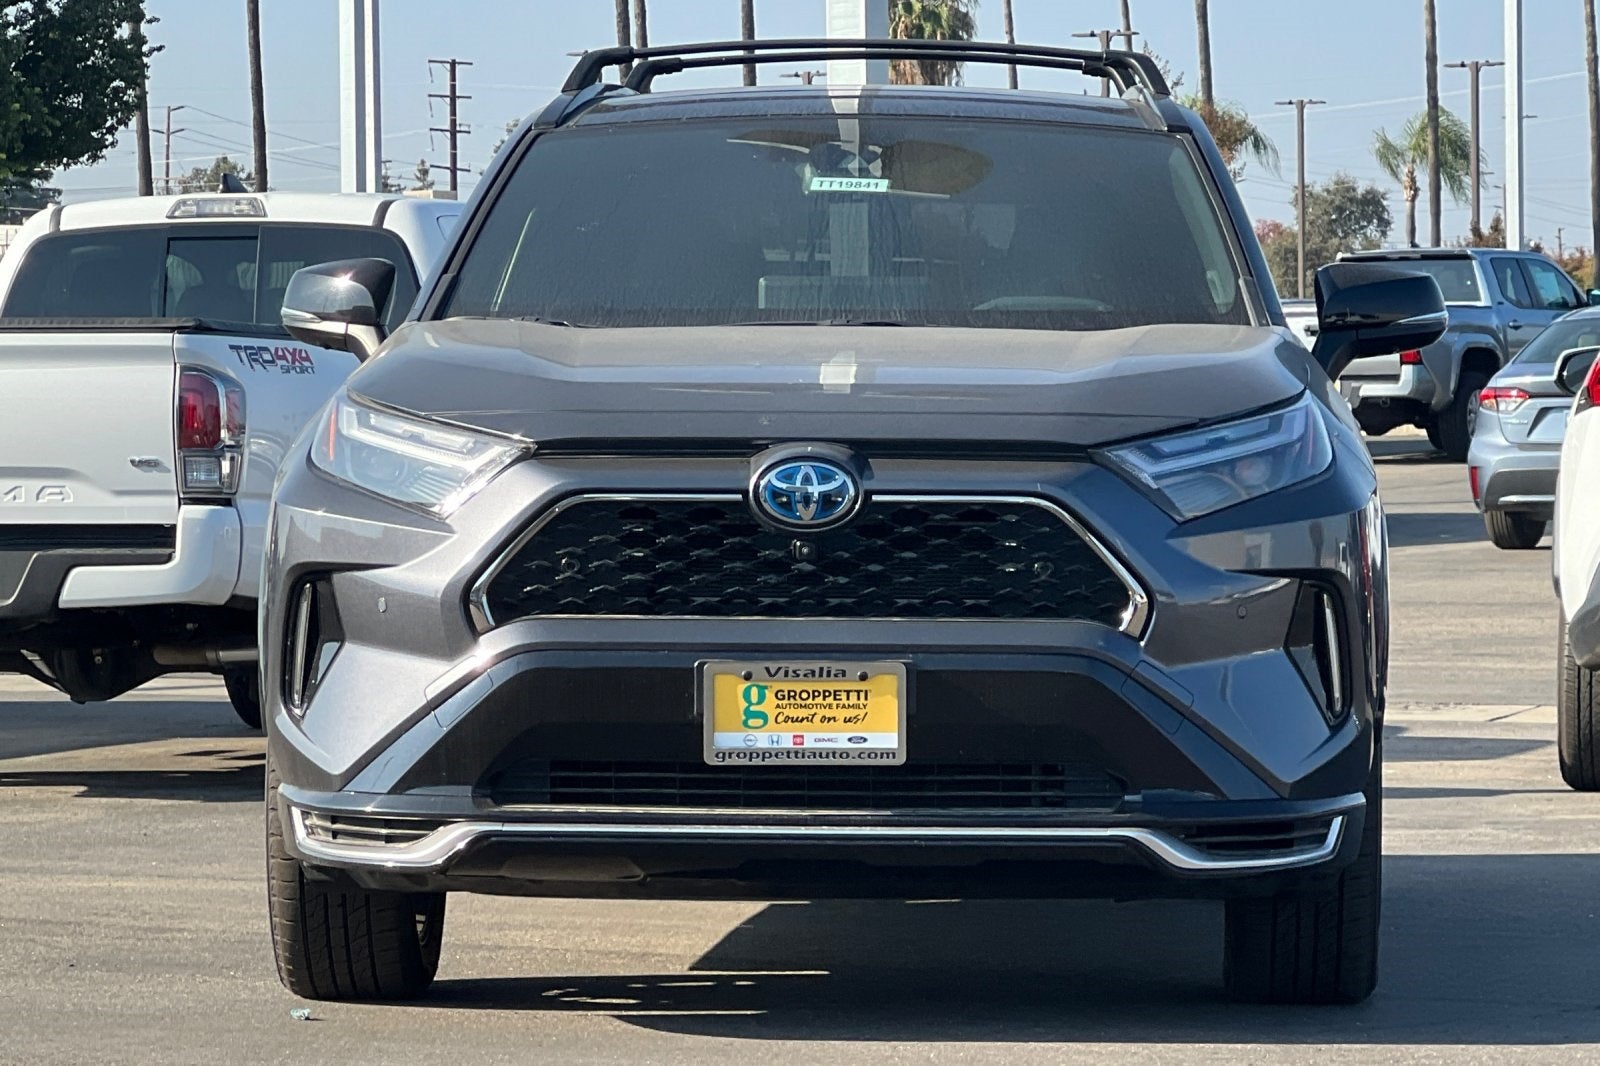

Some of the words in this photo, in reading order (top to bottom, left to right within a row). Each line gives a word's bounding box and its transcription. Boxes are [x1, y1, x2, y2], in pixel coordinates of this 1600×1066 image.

[816, 180, 880, 189] TT19841
[228, 344, 279, 372] TRD
[280, 365, 315, 375] SPORT
[764, 666, 847, 679] Visalia
[774, 689, 869, 701] GROPPETTI
[774, 711, 818, 725] Count
[819, 714, 840, 724] on
[842, 711, 869, 725] us!
[813, 736, 839, 744] GMC
[714, 749, 897, 763] groppettiauto.com
